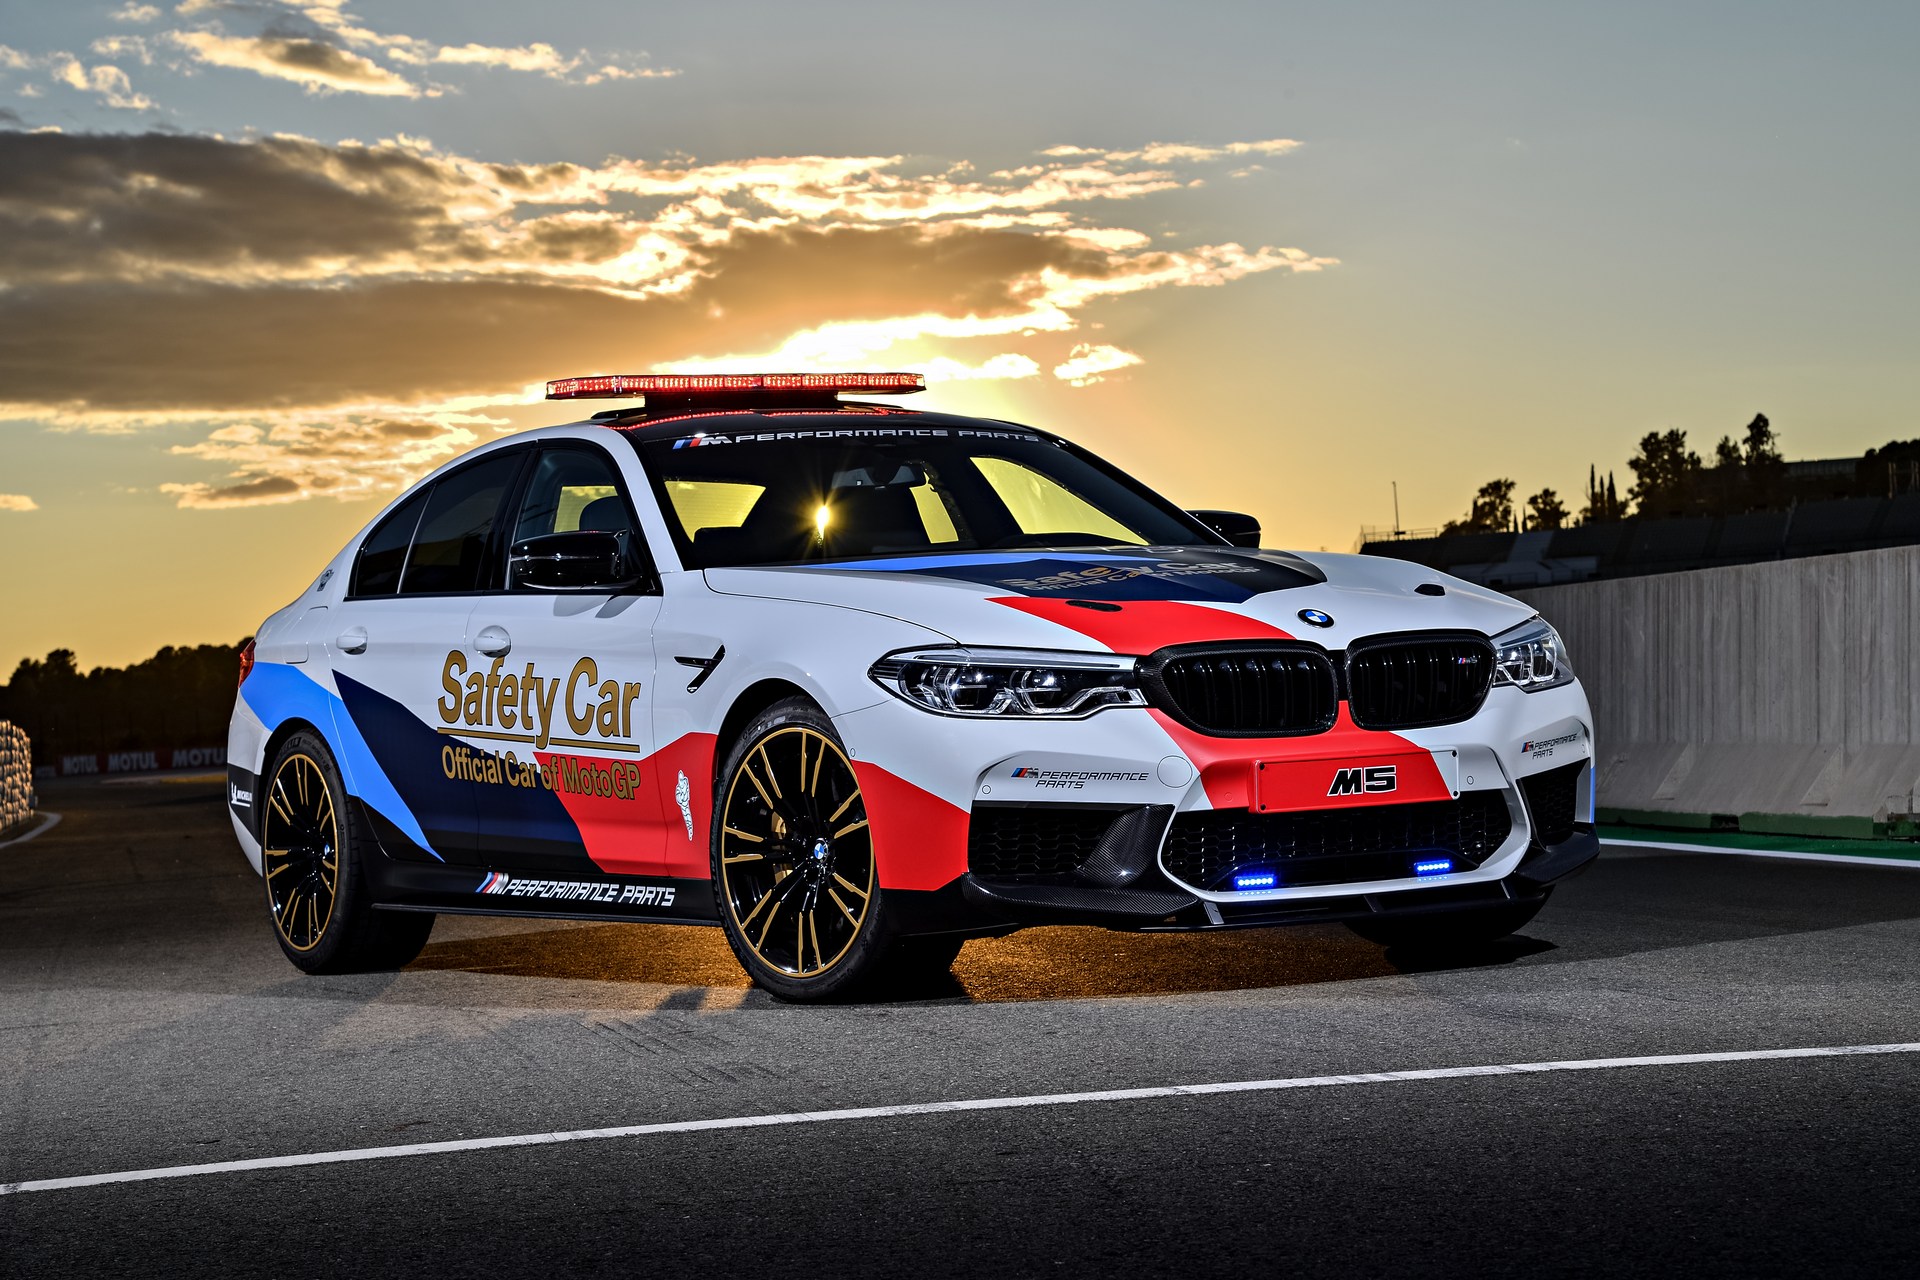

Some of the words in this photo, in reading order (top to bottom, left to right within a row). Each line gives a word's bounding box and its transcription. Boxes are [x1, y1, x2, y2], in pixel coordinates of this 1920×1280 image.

[735, 430, 948, 443] PERFORMANCE
[958, 430, 1039, 442] PARTS
[999, 566, 1154, 587] Safe
[1157, 562, 1238, 571] Car
[437, 649, 561, 749] Safety
[565, 656, 642, 738] Car
[1533, 733, 1578, 751] PERFORMANCE
[63, 754, 98, 775] MOTUL
[107, 751, 159, 772] MOTUL
[172, 747, 228, 768] MOTU
[1532, 748, 1554, 760] PARTS
[441, 744, 503, 784] Official
[504, 750, 537, 788] Car
[540, 755, 560, 791] of
[559, 756, 641, 800] MotoGP
[1038, 771, 1150, 781] PERFORMANCE
[1326, 765, 1397, 797] M5
[1035, 779, 1085, 789] PARTS
[502, 879, 620, 902] PERFORMANCE
[618, 885, 676, 907] PARTS
